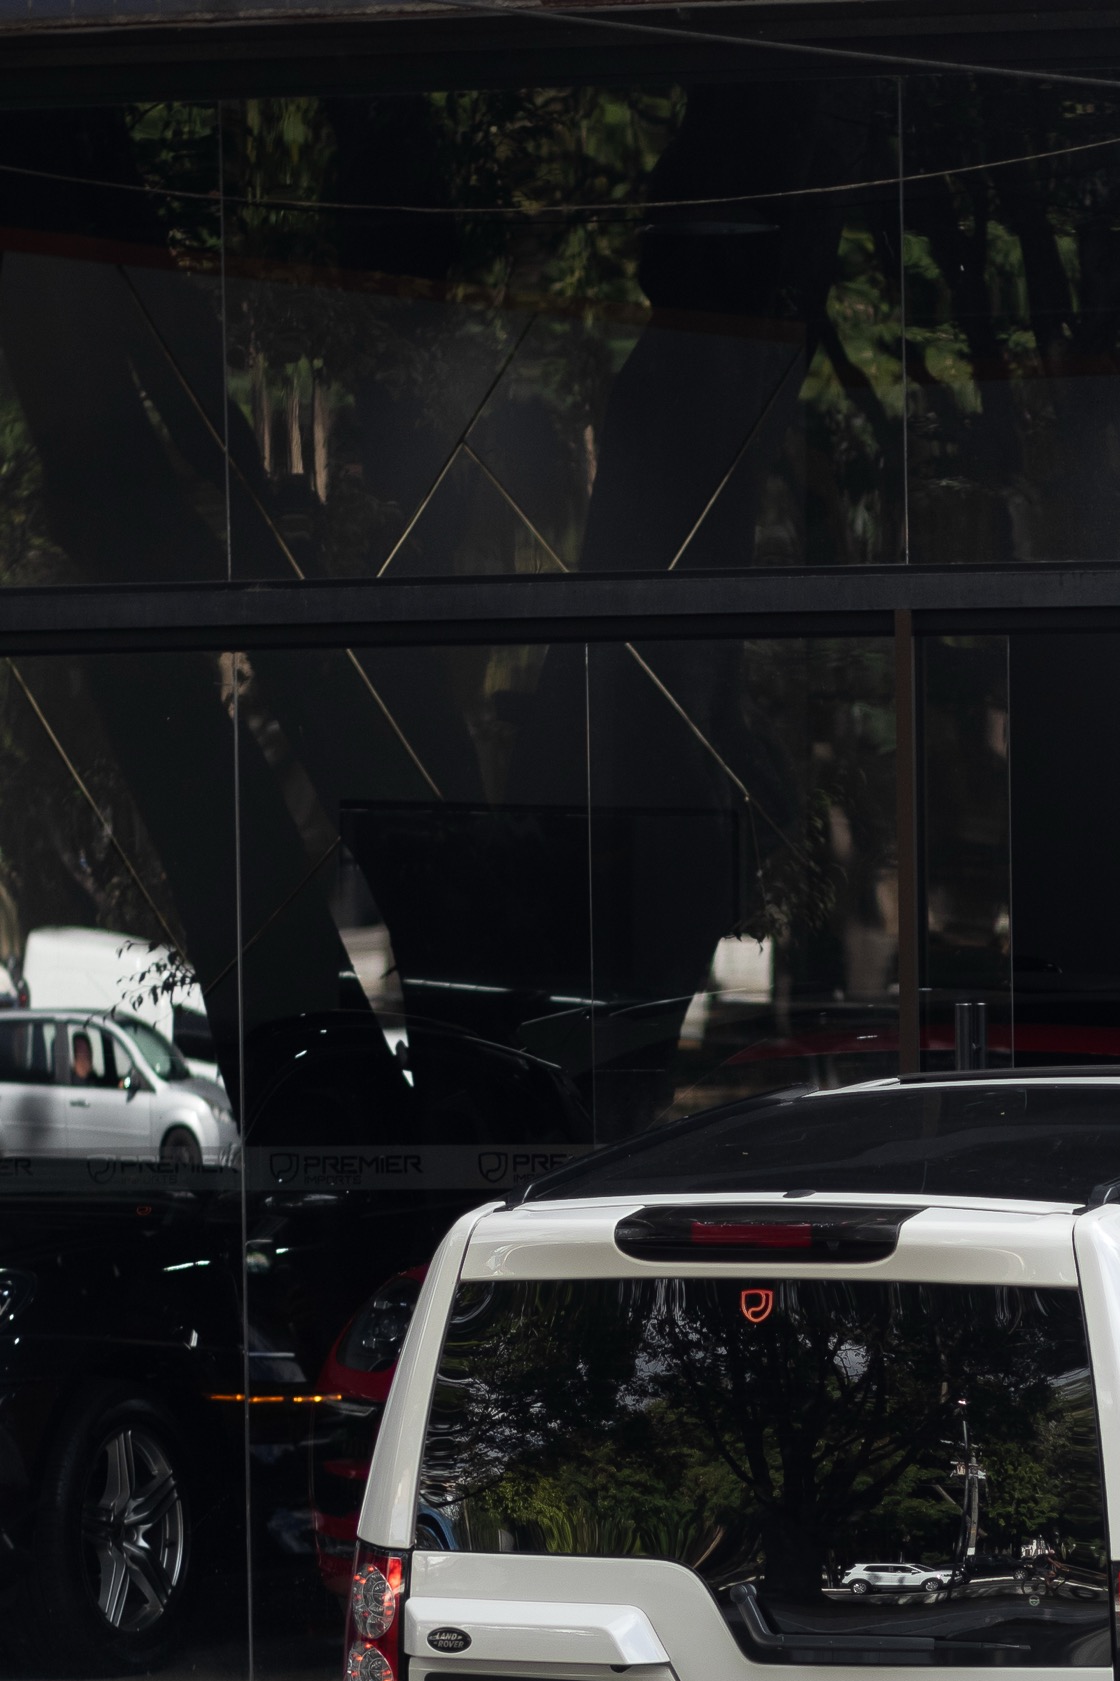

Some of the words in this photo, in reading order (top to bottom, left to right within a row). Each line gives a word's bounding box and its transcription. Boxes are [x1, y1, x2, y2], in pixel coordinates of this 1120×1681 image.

[303, 1155, 423, 1174] PREMIER
[303, 1174, 362, 1185] IMPORTS
[435, 1632, 458, 1640] LAND
[437, 1640, 465, 1649] ROVER
